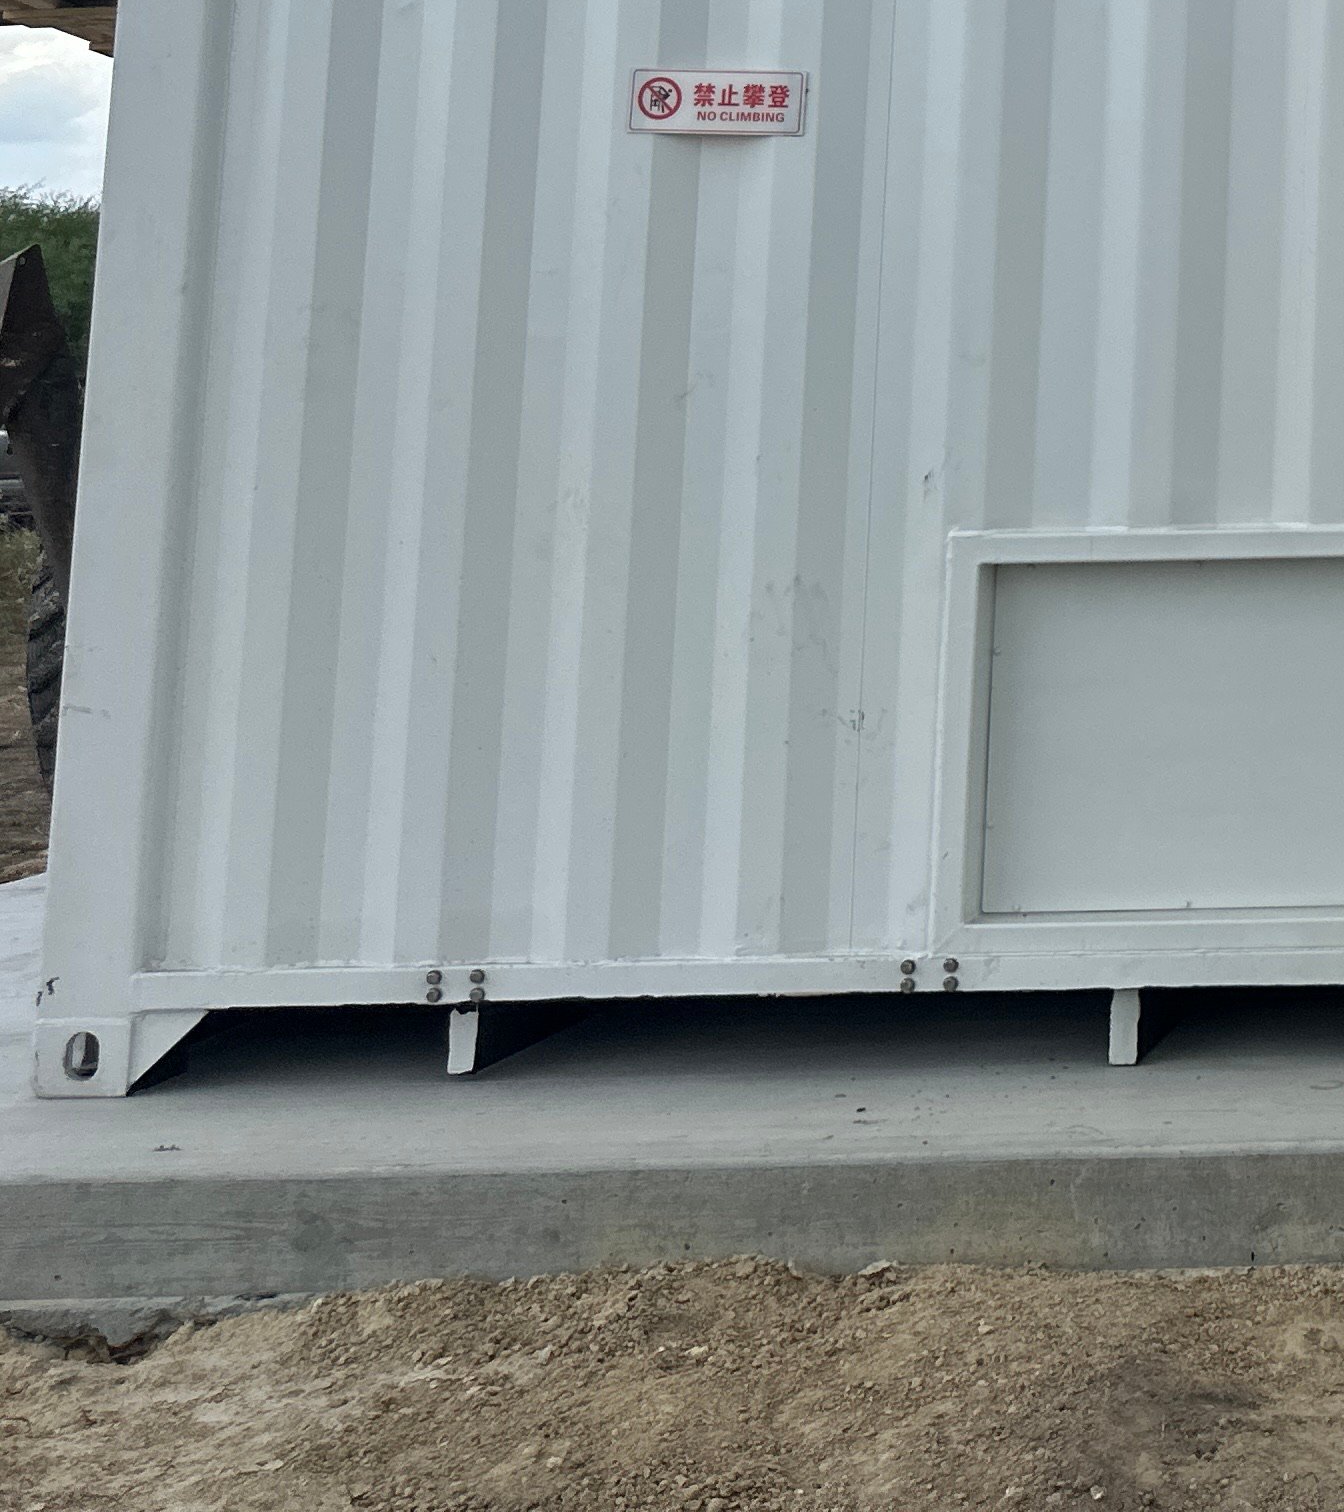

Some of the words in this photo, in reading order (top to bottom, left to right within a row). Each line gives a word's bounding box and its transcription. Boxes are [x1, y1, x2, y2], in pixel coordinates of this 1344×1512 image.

[693, 82, 790, 109] 禁止攀登
[696, 110, 717, 122] NO
[719, 111, 786, 123] CLIMBING
